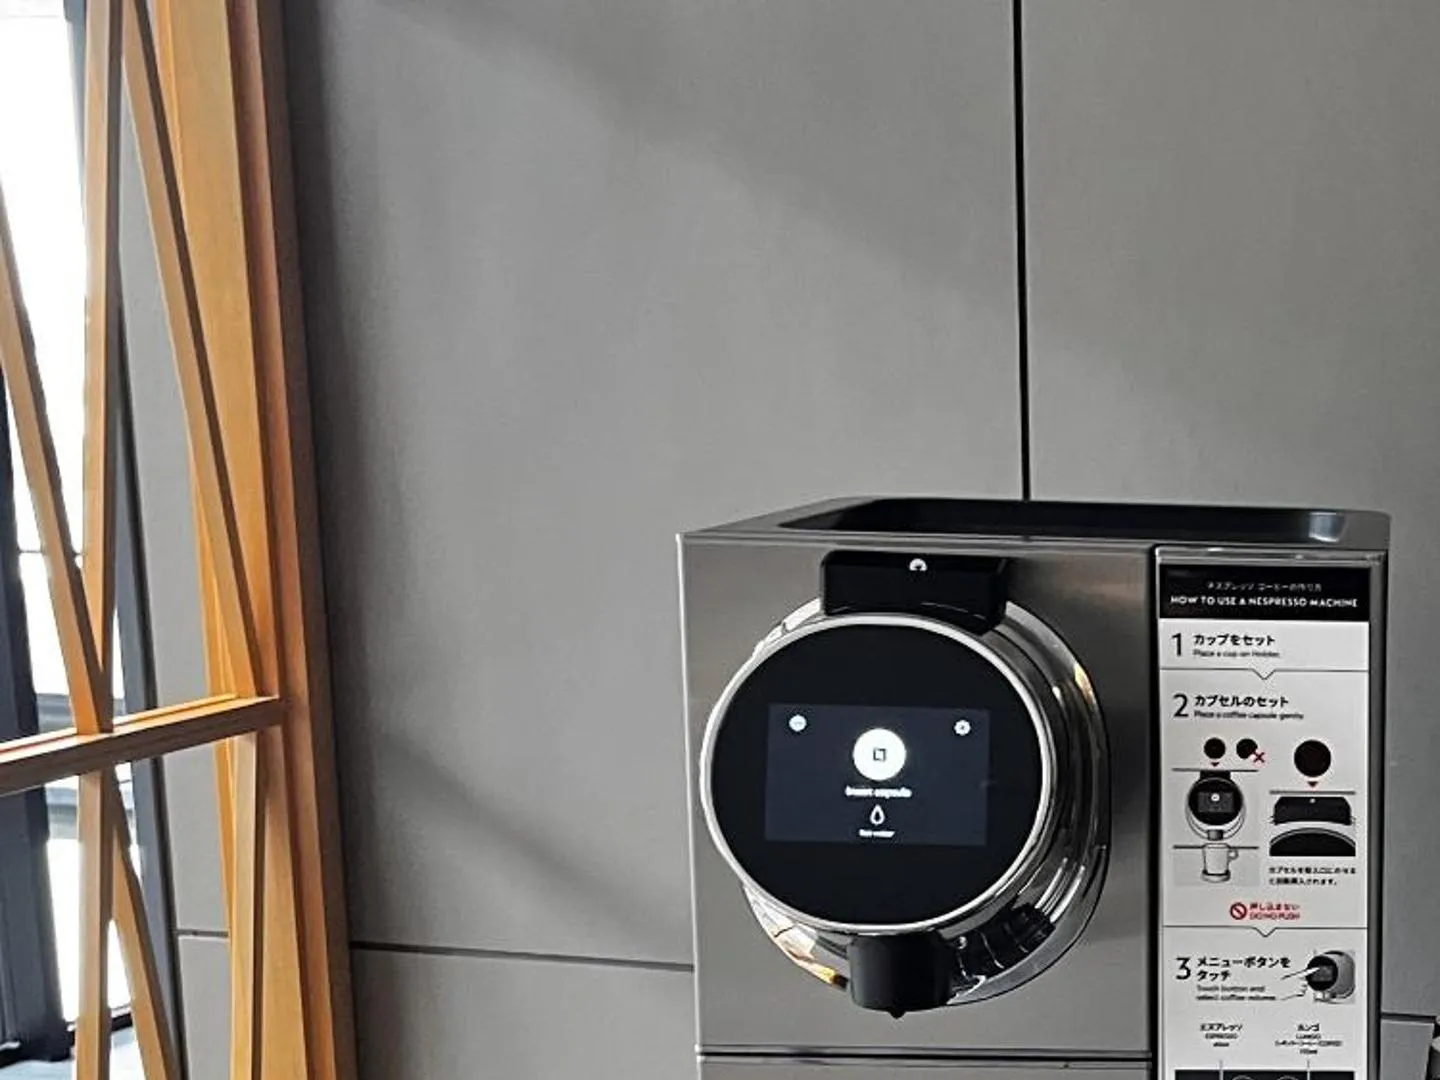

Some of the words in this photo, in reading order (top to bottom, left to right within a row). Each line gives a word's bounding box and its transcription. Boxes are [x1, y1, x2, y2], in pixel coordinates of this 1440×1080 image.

[1170, 595, 1198, 605] HOW
[1201, 595, 1216, 606] TO
[1217, 596, 1237, 606] USE
[1239, 597, 1247, 606] A
[1248, 596, 1307, 608] NESPRESSO
[1309, 598, 1358, 608] MACHINE
[1171, 633, 1182, 657] 1
[1193, 633, 1276, 647] カップをセット
[1172, 693, 1189, 718] 2
[1194, 694, 1290, 708] カプセルのセット
[1175, 957, 1191, 980] 3
[1197, 956, 1291, 969] メニューボタンを
[1196, 970, 1231, 982] タッチ
